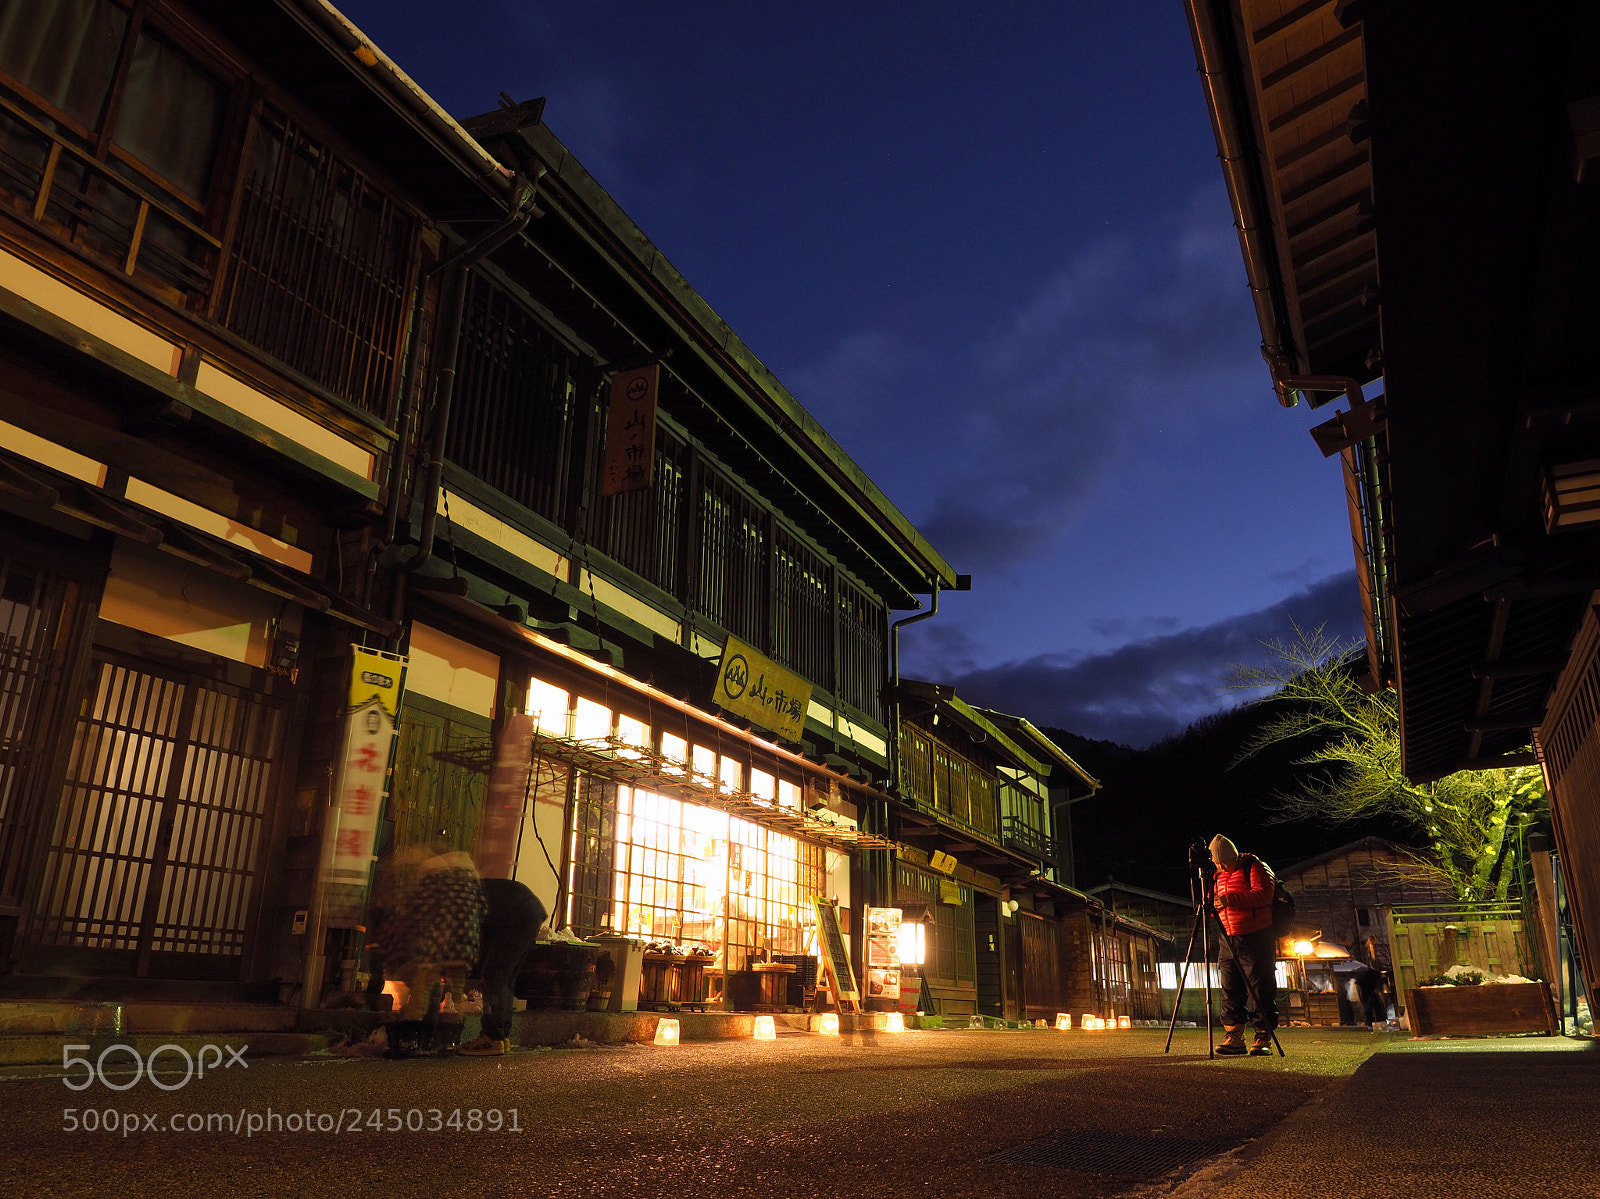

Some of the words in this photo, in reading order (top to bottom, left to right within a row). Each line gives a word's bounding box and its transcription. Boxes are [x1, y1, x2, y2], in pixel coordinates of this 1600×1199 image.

[624, 409, 646, 480] 山の市場
[748, 674, 803, 723] 山の市場
